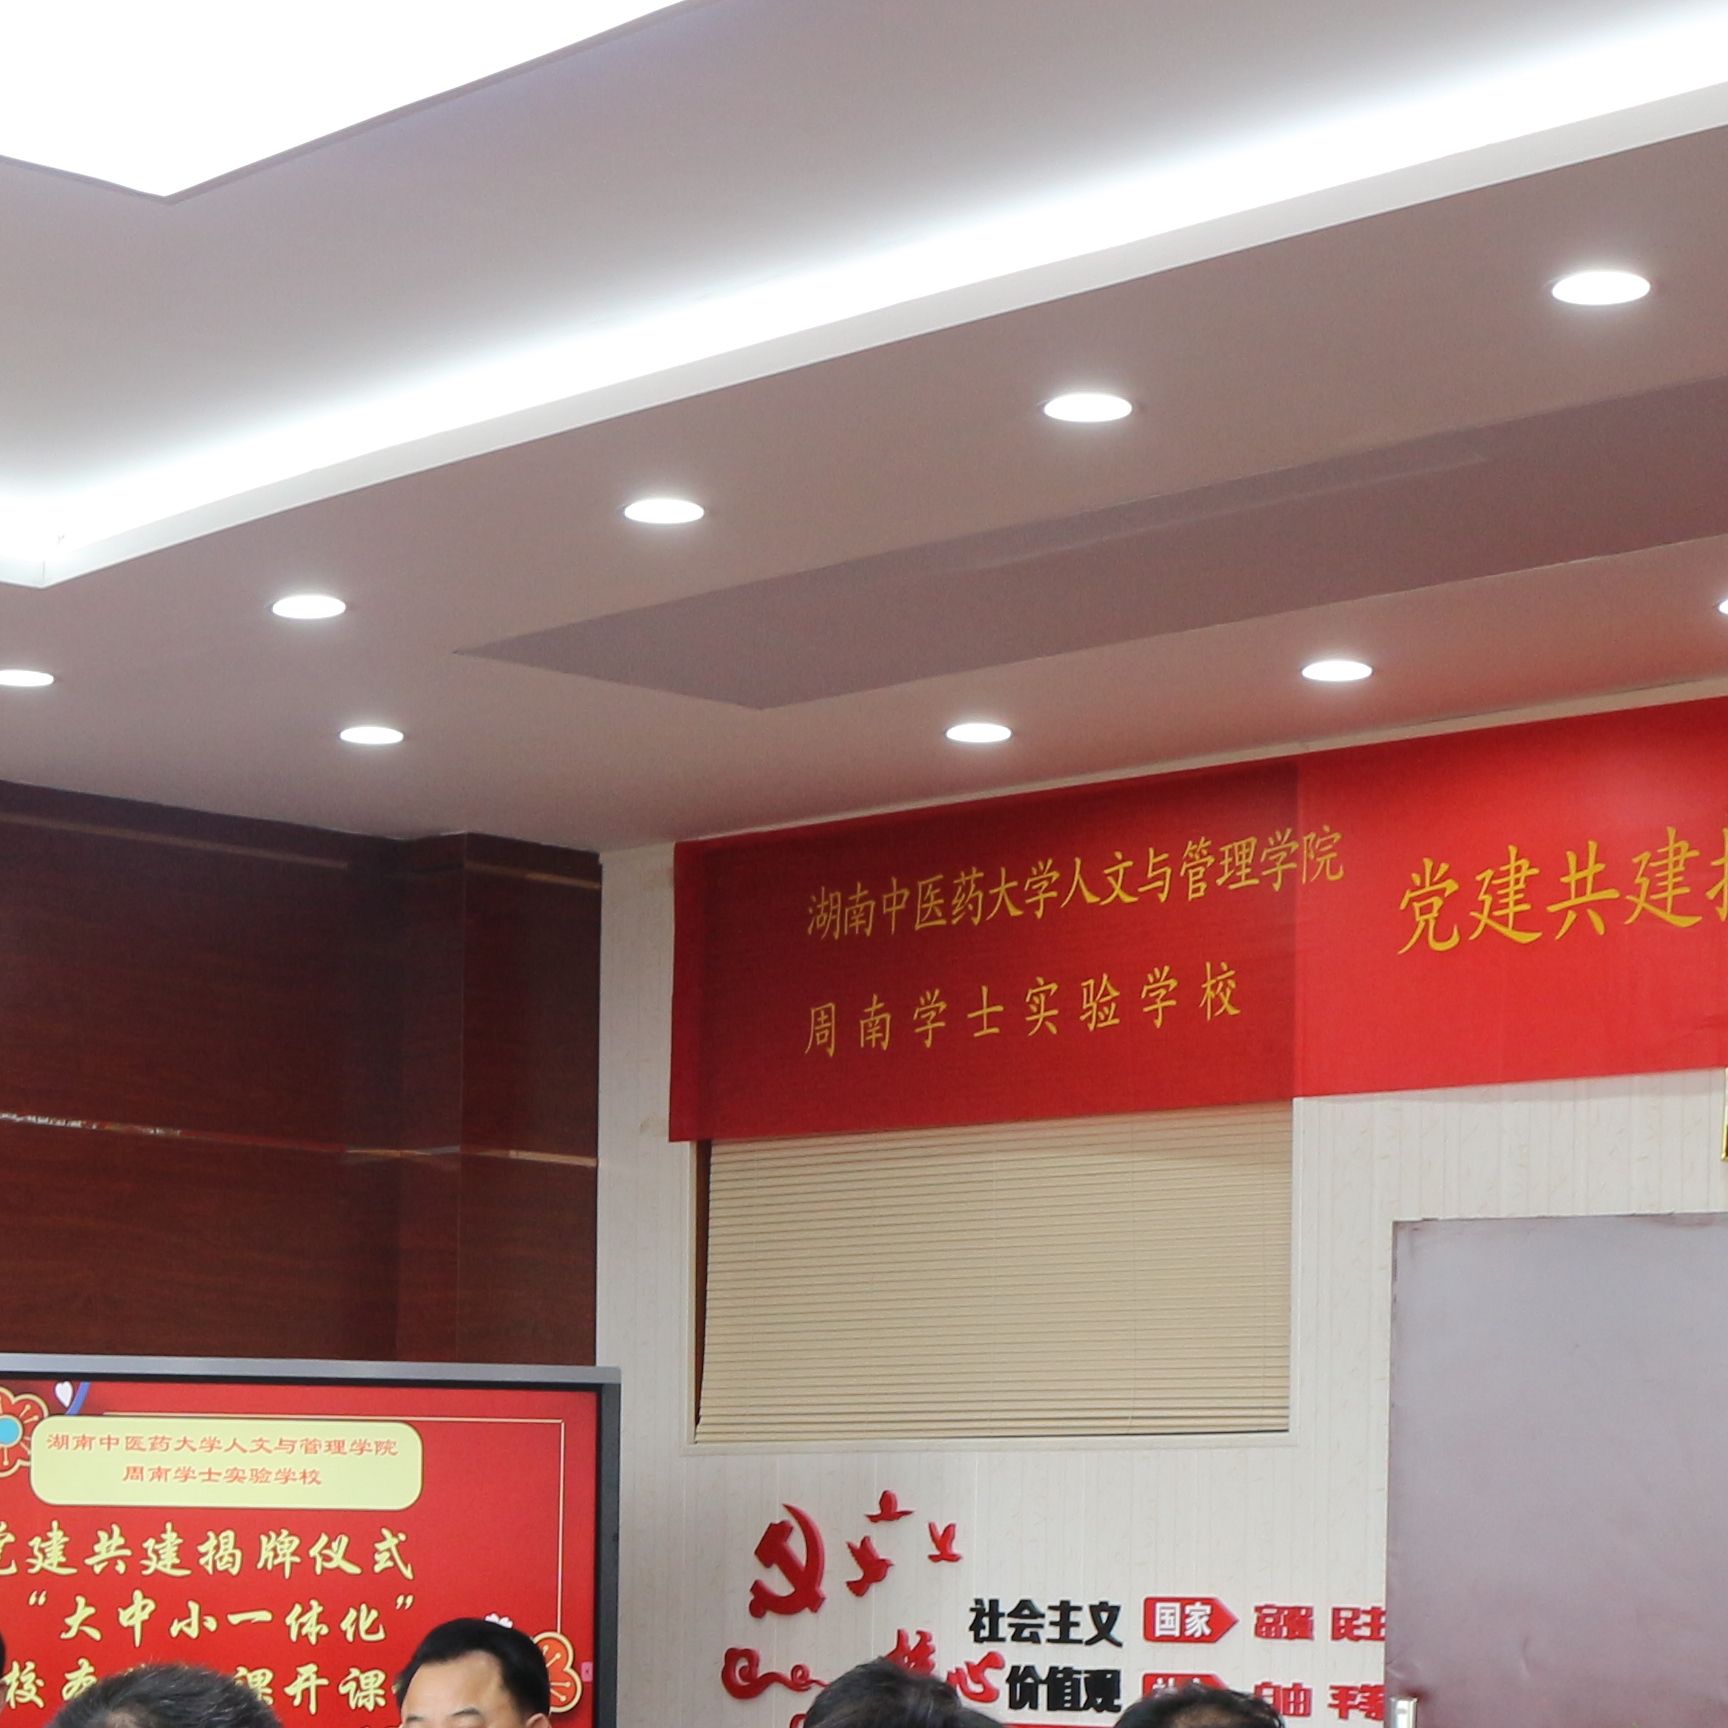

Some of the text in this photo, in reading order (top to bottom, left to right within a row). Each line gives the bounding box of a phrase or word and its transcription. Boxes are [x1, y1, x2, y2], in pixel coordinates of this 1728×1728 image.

[806, 824, 1345, 941] 湖南中医药大学人文与管理学院
[804, 961, 1241, 1058] 周南学士实验学校
[46, 1432, 399, 1457] 湖南中医药大学人文与管理学院
[121, 1465, 323, 1486] 周南学士实验学校
[1153, 1601, 1213, 1639] 国家
[1005, 1665, 1123, 1714] 价值观
